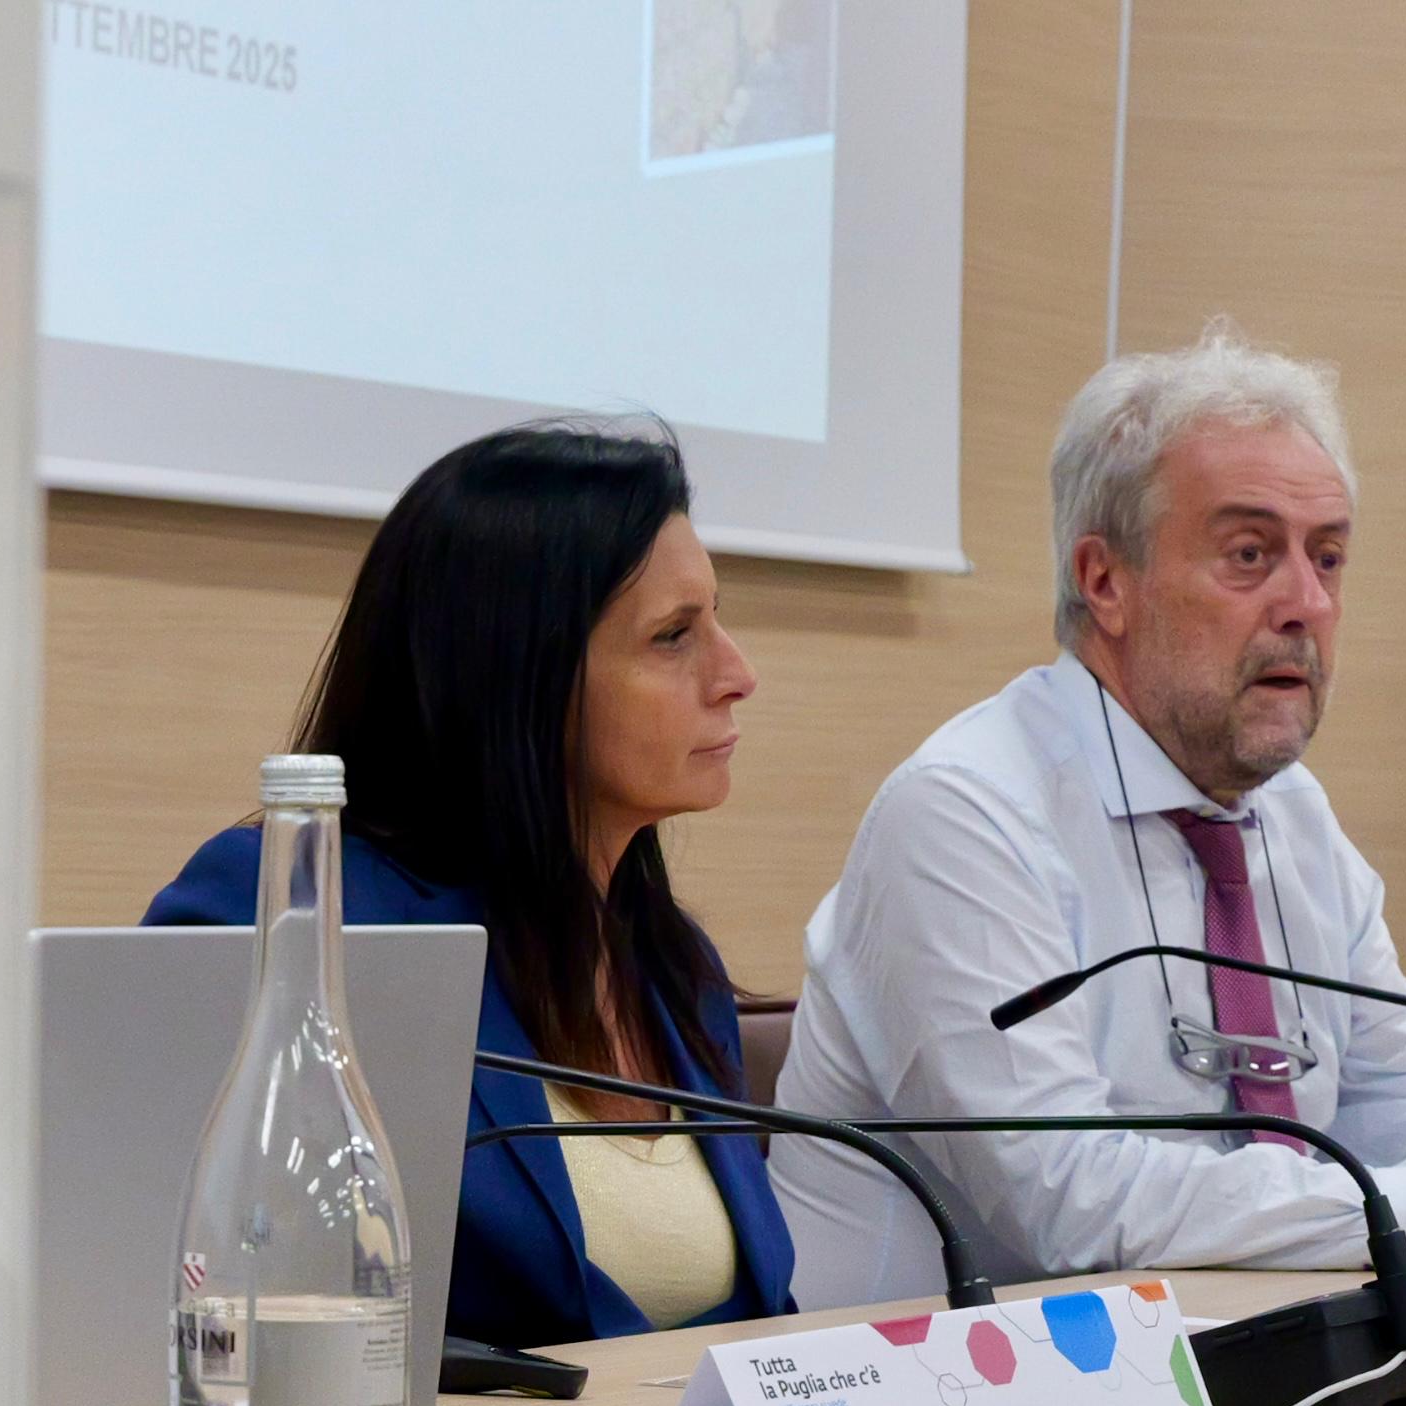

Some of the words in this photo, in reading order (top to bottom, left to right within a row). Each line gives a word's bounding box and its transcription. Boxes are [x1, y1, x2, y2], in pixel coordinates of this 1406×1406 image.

[225, 32, 298, 94] 2025
[749, 1357, 798, 1378] Tutta
[759, 1380, 778, 1401] la
[777, 1373, 829, 1400] Puglia
[829, 1369, 858, 1391] che
[859, 1363, 883, 1387] c'è
